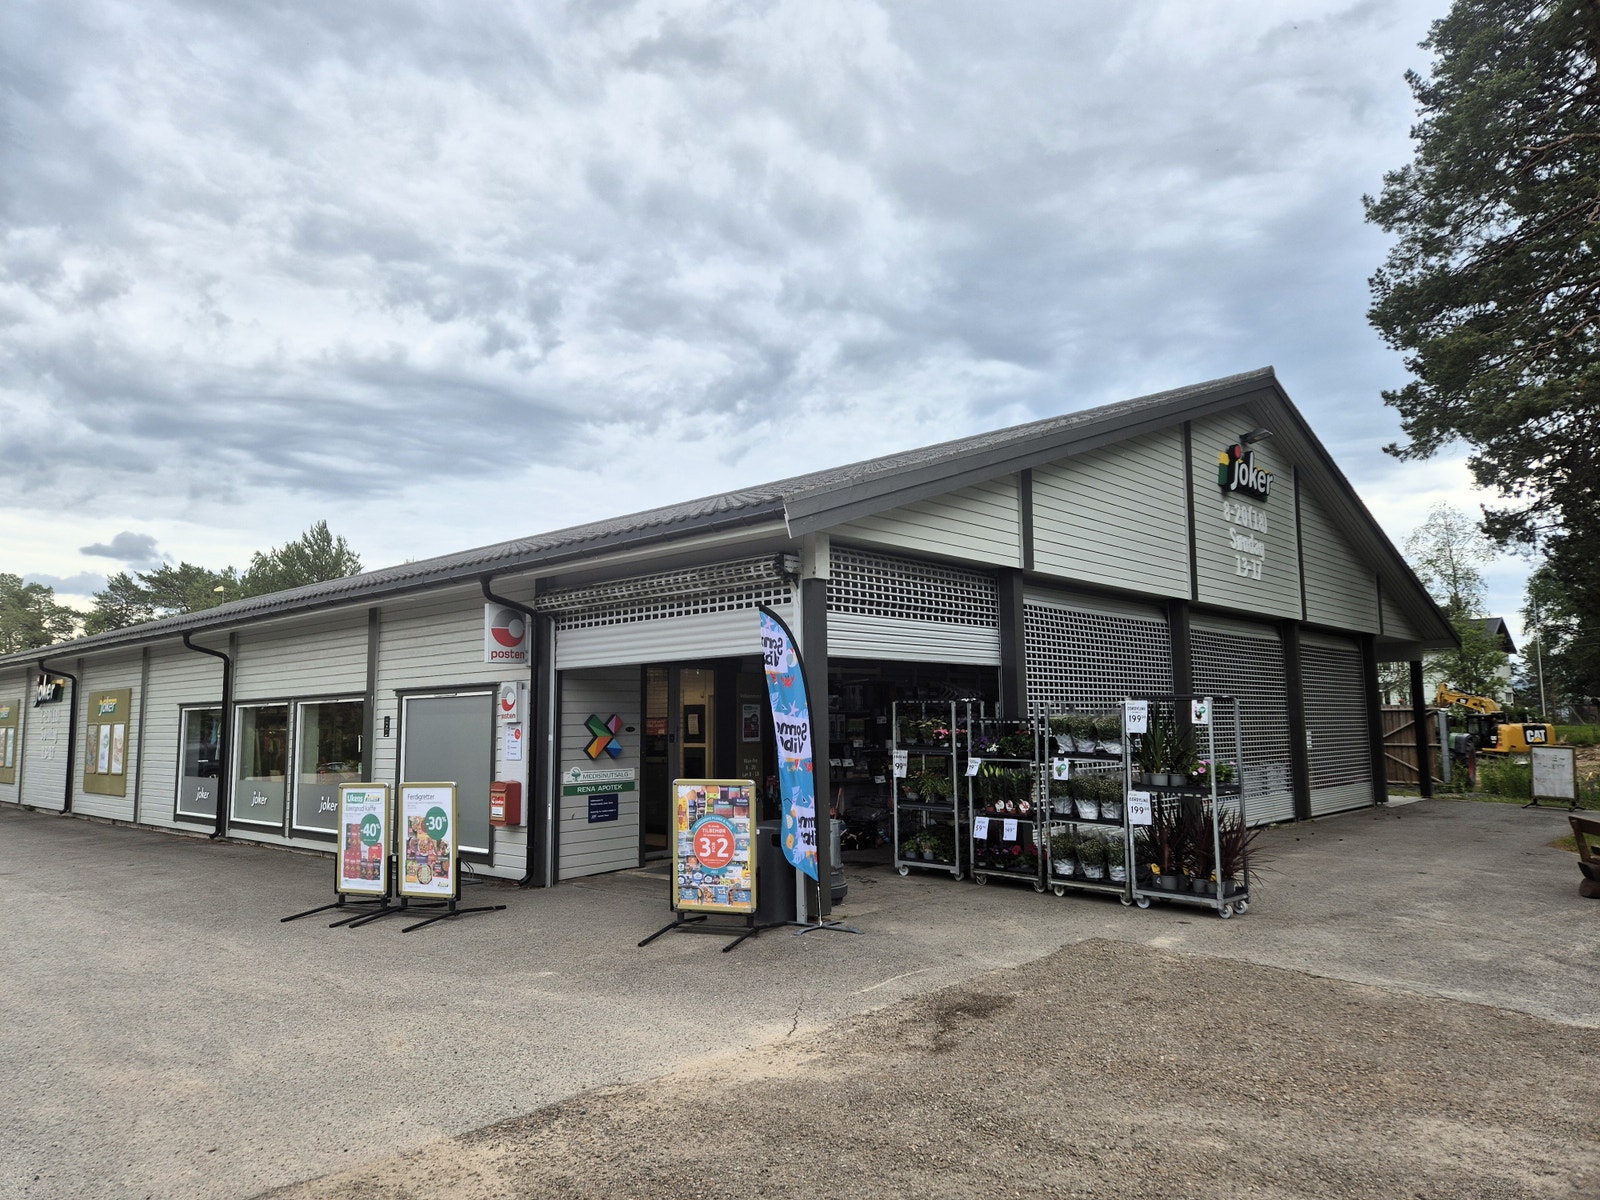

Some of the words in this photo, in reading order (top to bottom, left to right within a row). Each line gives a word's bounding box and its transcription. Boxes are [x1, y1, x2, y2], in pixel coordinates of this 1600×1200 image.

[1231, 444, 1273, 494] joker
[491, 650, 525, 660] posten
[1525, 729, 1546, 743] CAT
[196, 787, 210, 801] joker
[598, 784, 623, 792] APOTEK
[251, 791, 268, 807] joker
[347, 794, 363, 803] Ukens
[407, 793, 435, 801] Ferdigretter
[319, 796, 338, 813] joker
[700, 838, 711, 857] 3
[717, 838, 728, 857] 2
